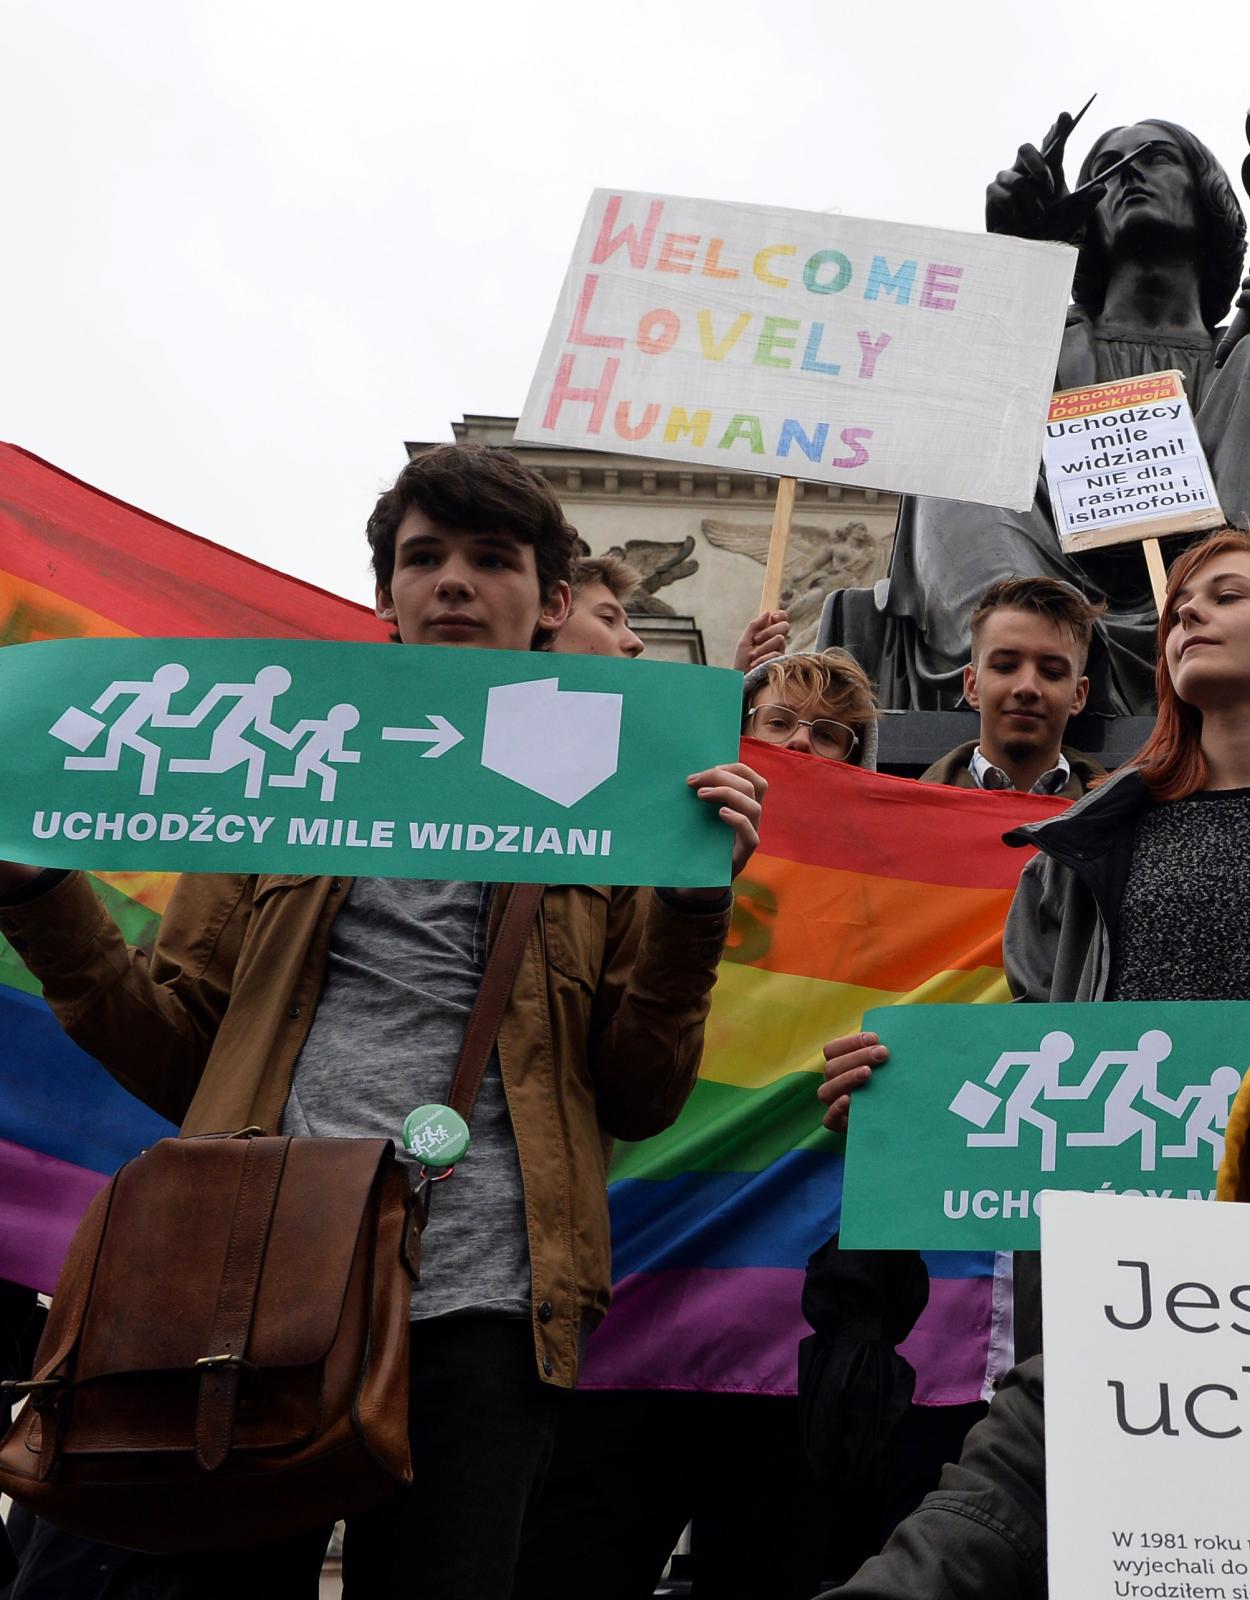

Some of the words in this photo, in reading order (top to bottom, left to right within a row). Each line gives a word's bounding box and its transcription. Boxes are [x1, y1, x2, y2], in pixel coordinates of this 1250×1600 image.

[589, 195, 964, 312] WELCOME
[566, 273, 892, 380] LOVELY
[542, 353, 875, 470] HUMANS
[1052, 388, 1171, 418] Demokracja
[1091, 428, 1148, 450] mile
[1061, 438, 1186, 474] widziani!
[1078, 481, 1174, 507] rasizmu
[1182, 476, 1189, 487] i
[1087, 472, 1129, 489] NIE
[1137, 466, 1172, 480] dla
[1069, 489, 1205, 525] islamofobii
[31, 808, 275, 844] UCHODŹCY
[287, 818, 396, 849] MILE
[409, 822, 613, 857] WIDZIANI
[1112, 1532, 1133, 1547] W
[1140, 1533, 1188, 1549] 1981
[1194, 1535, 1241, 1551] roku
[1113, 1557, 1215, 1577] wyjechali
[1221, 1559, 1248, 1574] do
[1114, 1581, 1225, 1600] Urodziłem
